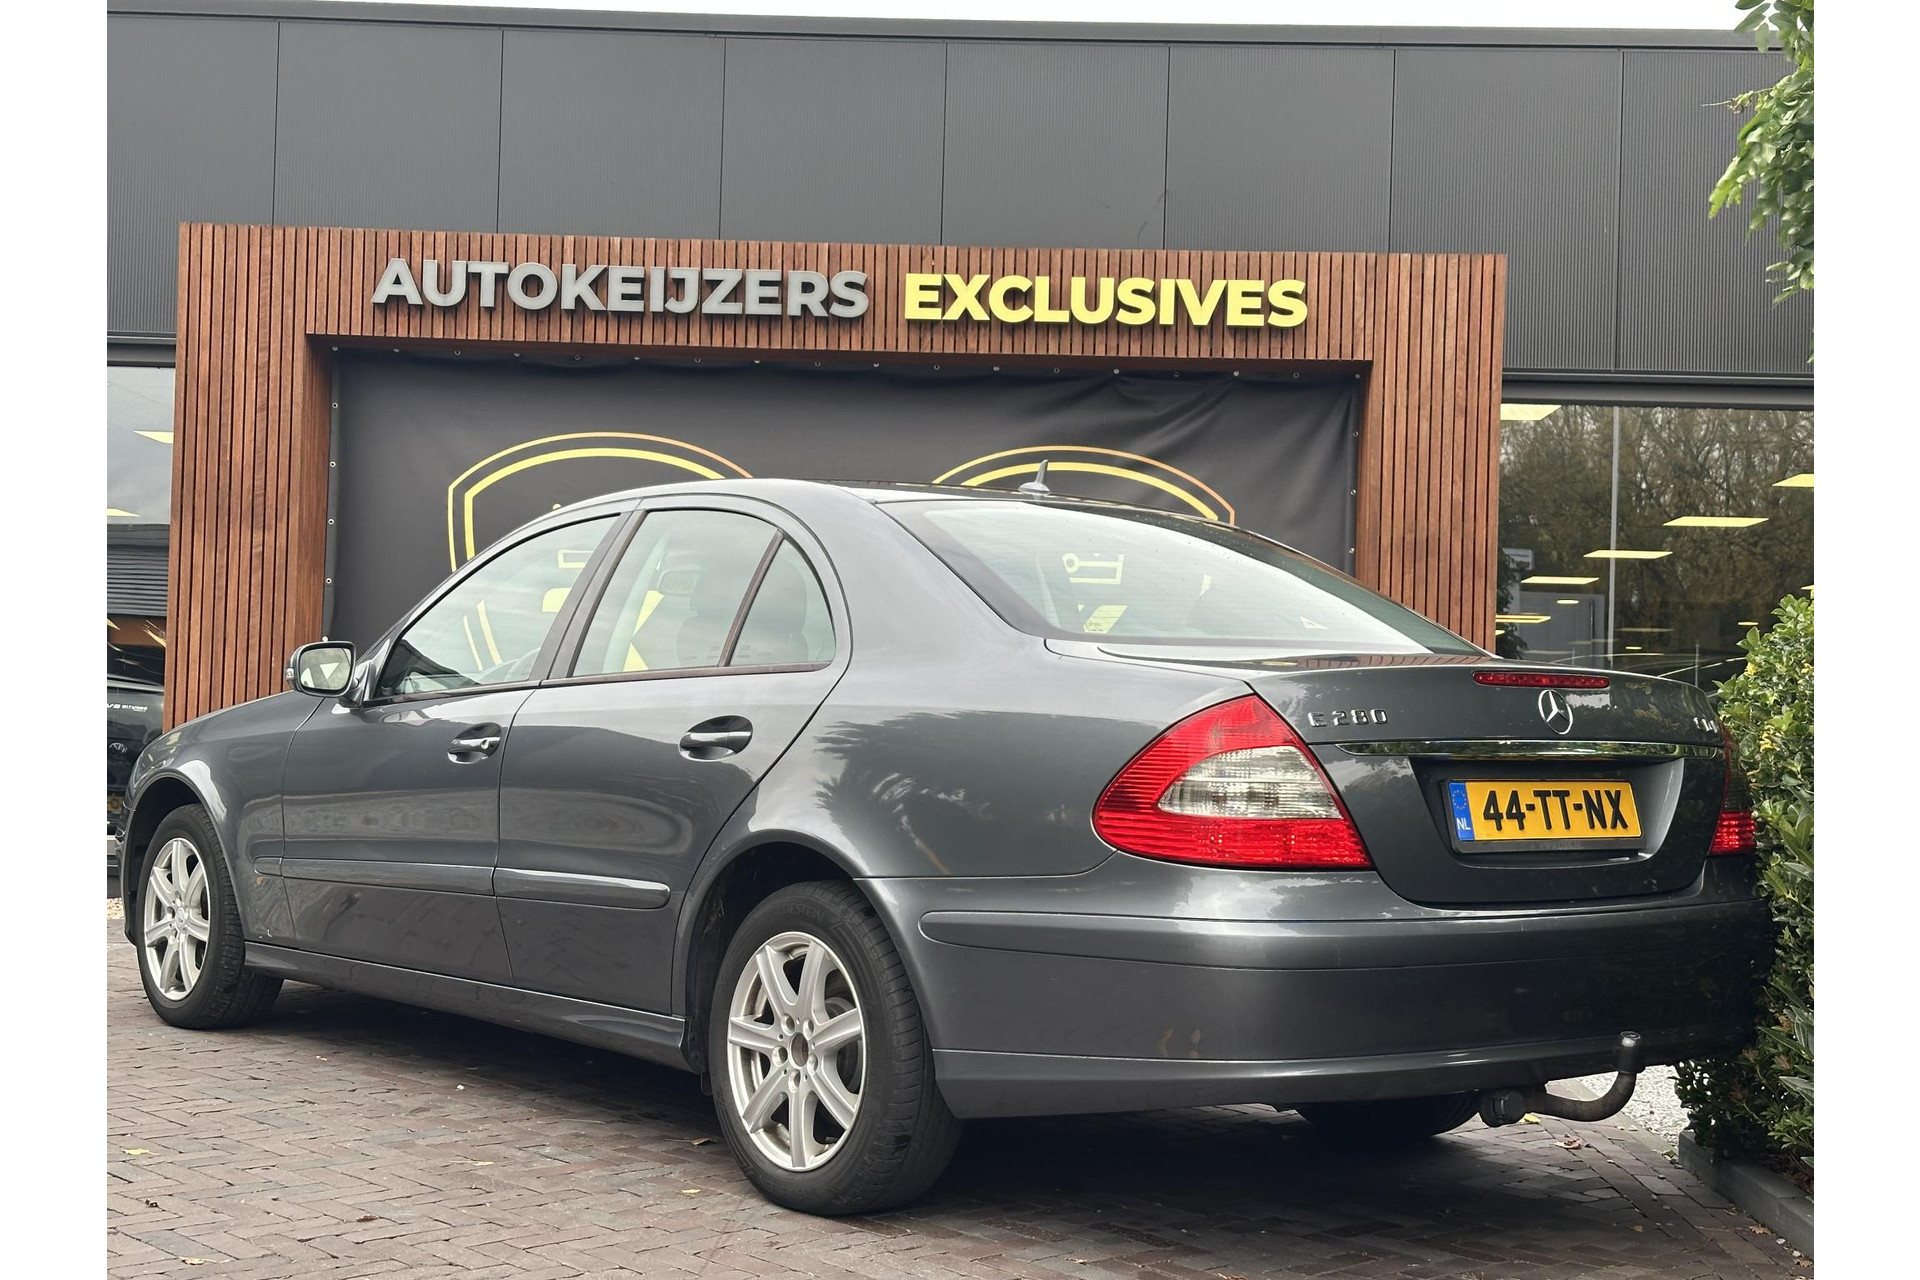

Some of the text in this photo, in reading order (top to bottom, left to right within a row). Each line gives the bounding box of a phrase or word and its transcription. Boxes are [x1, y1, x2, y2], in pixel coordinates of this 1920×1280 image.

[371, 257, 1309, 328] AUTOKEIJZERS EXCLUSIVES
[1307, 708, 1388, 728] E 280
[1456, 817, 1471, 831] NL
[1482, 789, 1629, 831] 44-TT-NX
